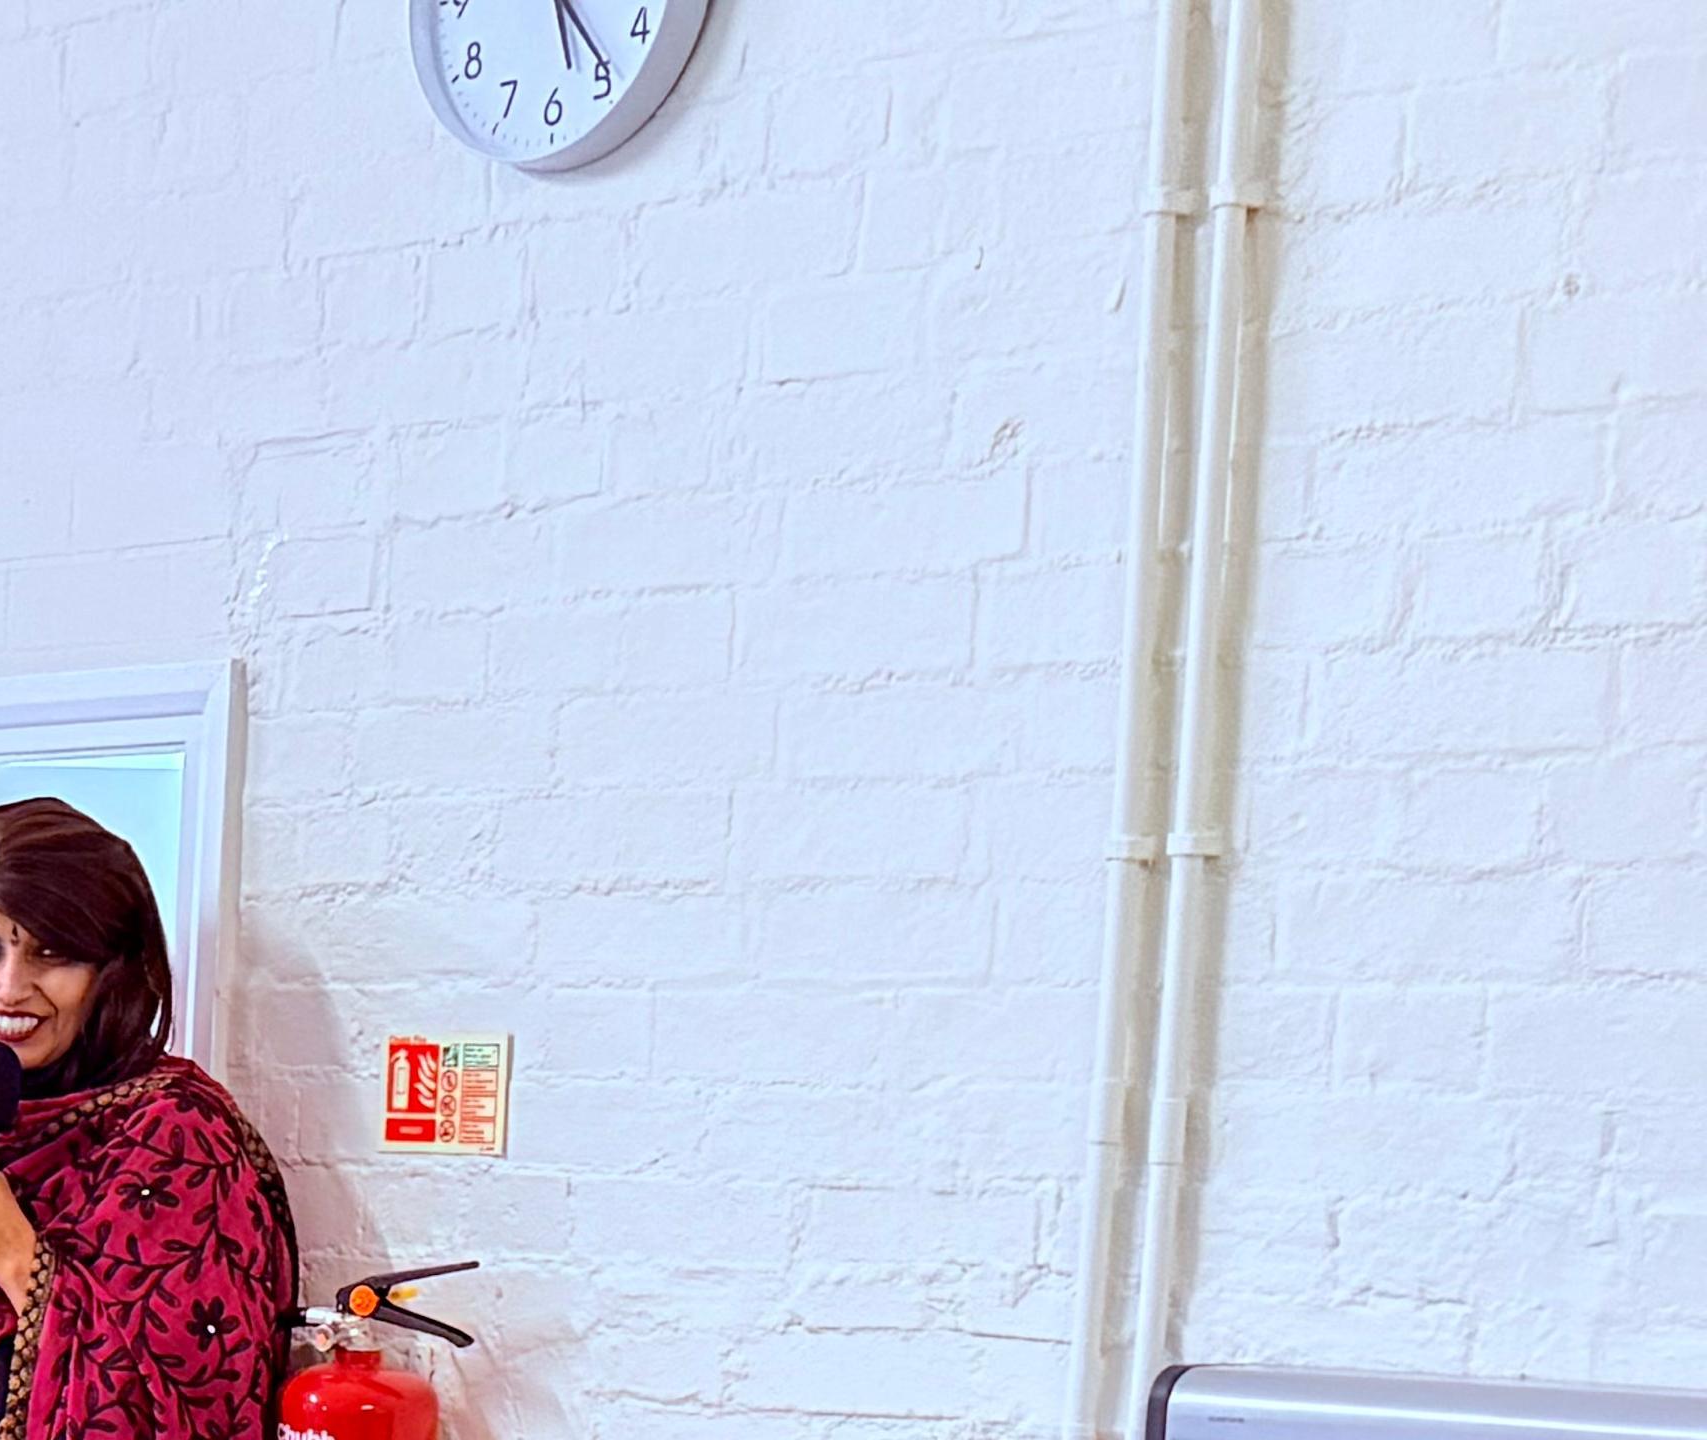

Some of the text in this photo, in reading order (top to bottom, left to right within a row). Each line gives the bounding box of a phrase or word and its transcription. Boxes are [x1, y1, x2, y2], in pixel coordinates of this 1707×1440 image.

[630, 7, 650, 44] 4
[464, 41, 483, 80] 8
[593, 60, 612, 100] 5
[500, 80, 518, 119] 7
[543, 88, 563, 126] 6
